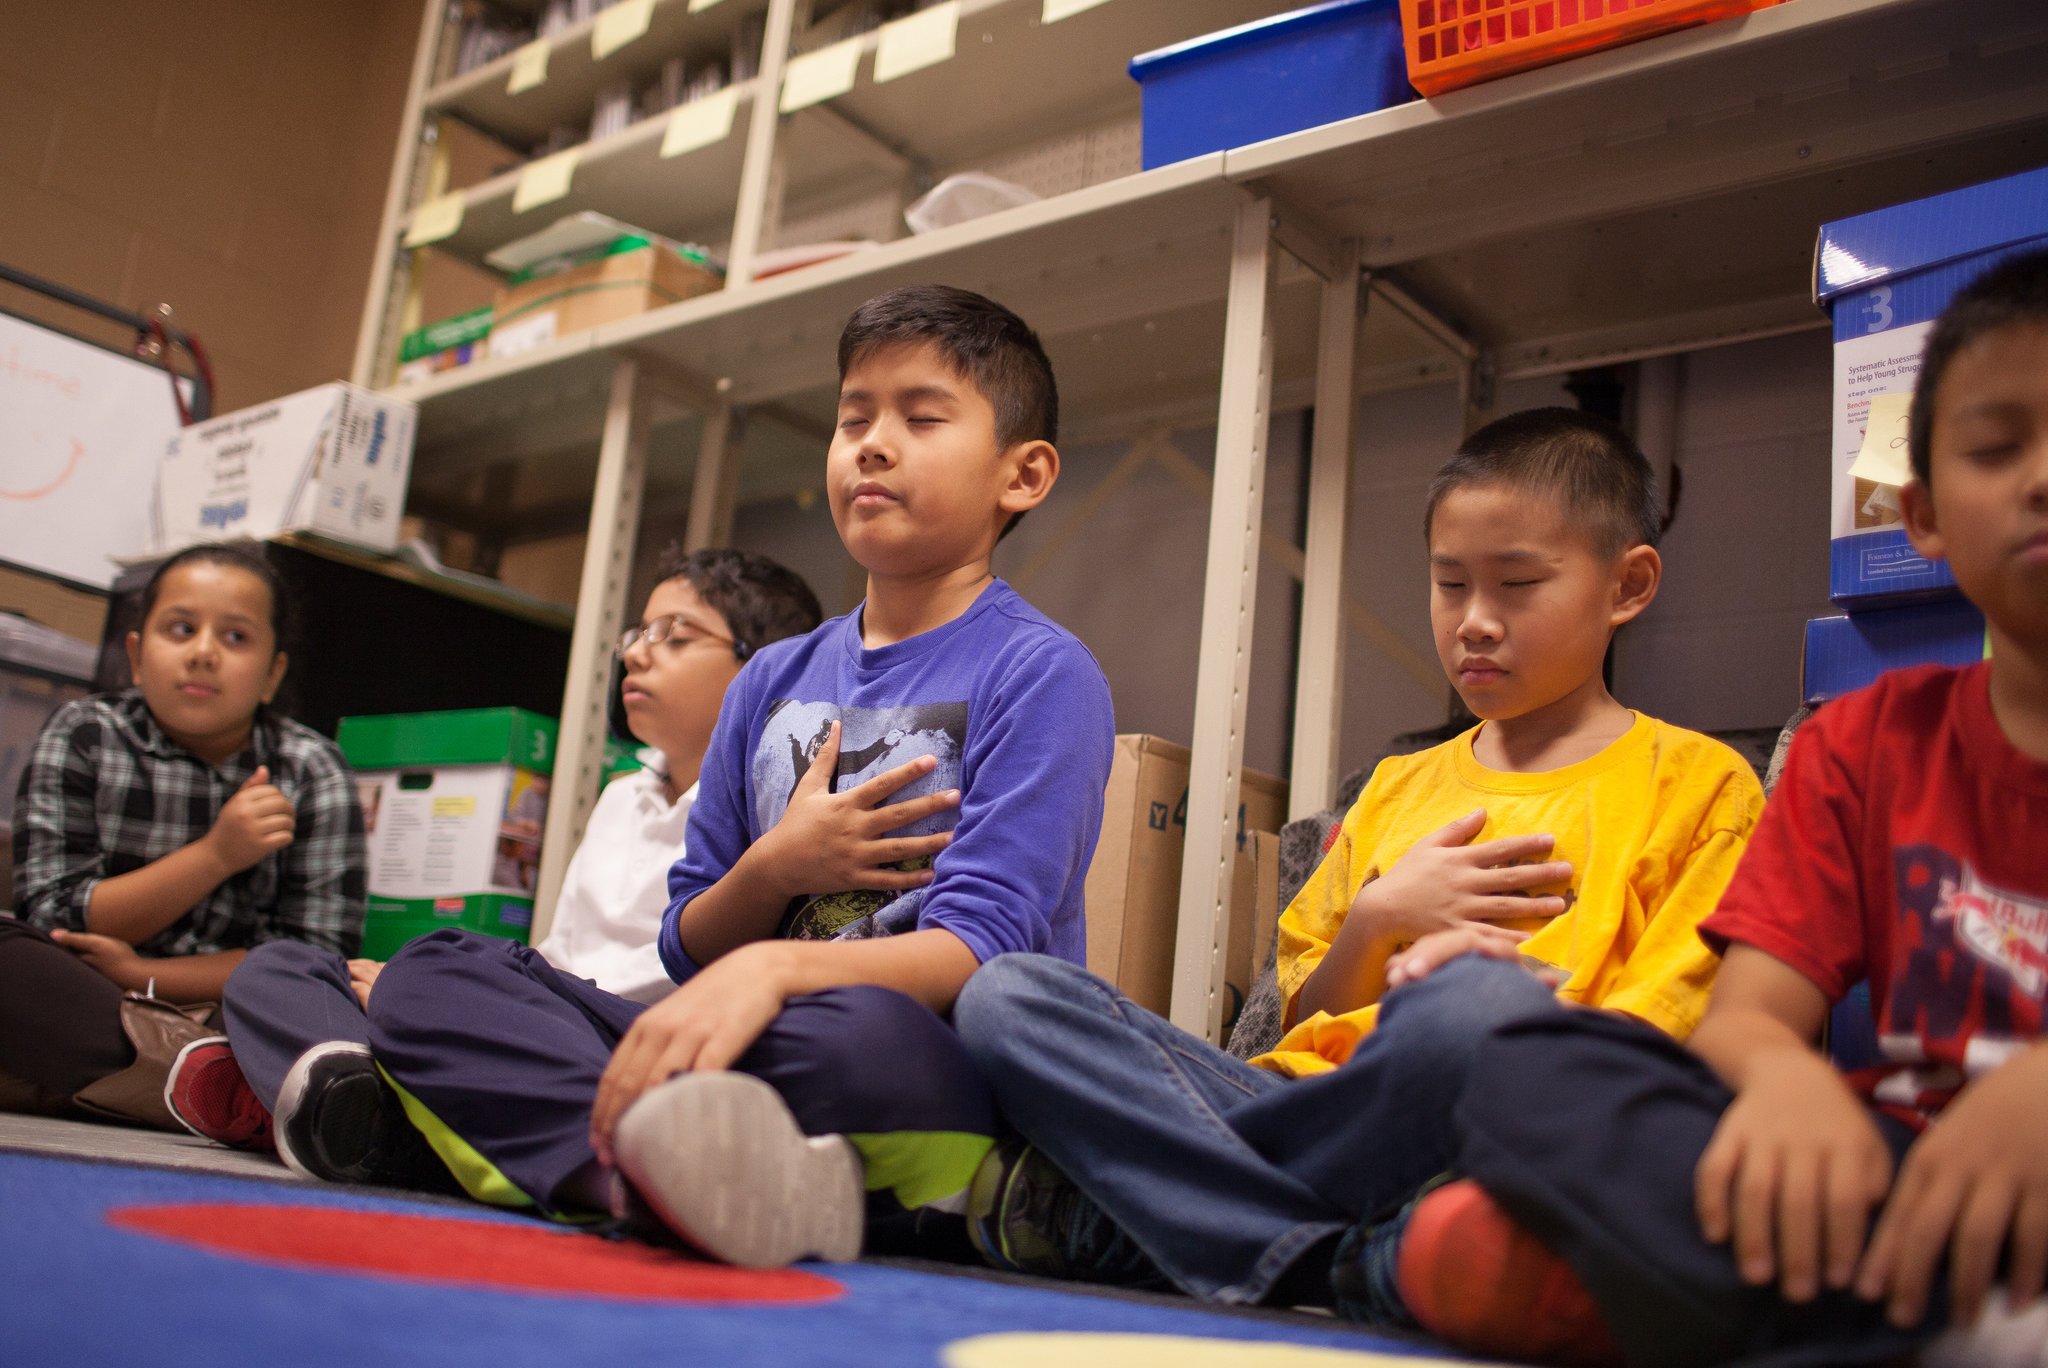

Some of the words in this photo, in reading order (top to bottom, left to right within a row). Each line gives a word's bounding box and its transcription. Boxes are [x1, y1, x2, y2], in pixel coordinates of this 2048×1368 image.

[1868, 286, 1893, 332] 3
[1848, 360, 1886, 375] Systematic
[1887, 353, 1922, 365] Assessme
[1857, 373, 1873, 383] Help
[1874, 369, 1896, 377] Young
[1897, 363, 1921, 374] Strugg
[1847, 390, 1866, 398] step
[532, 728, 548, 762] 3
